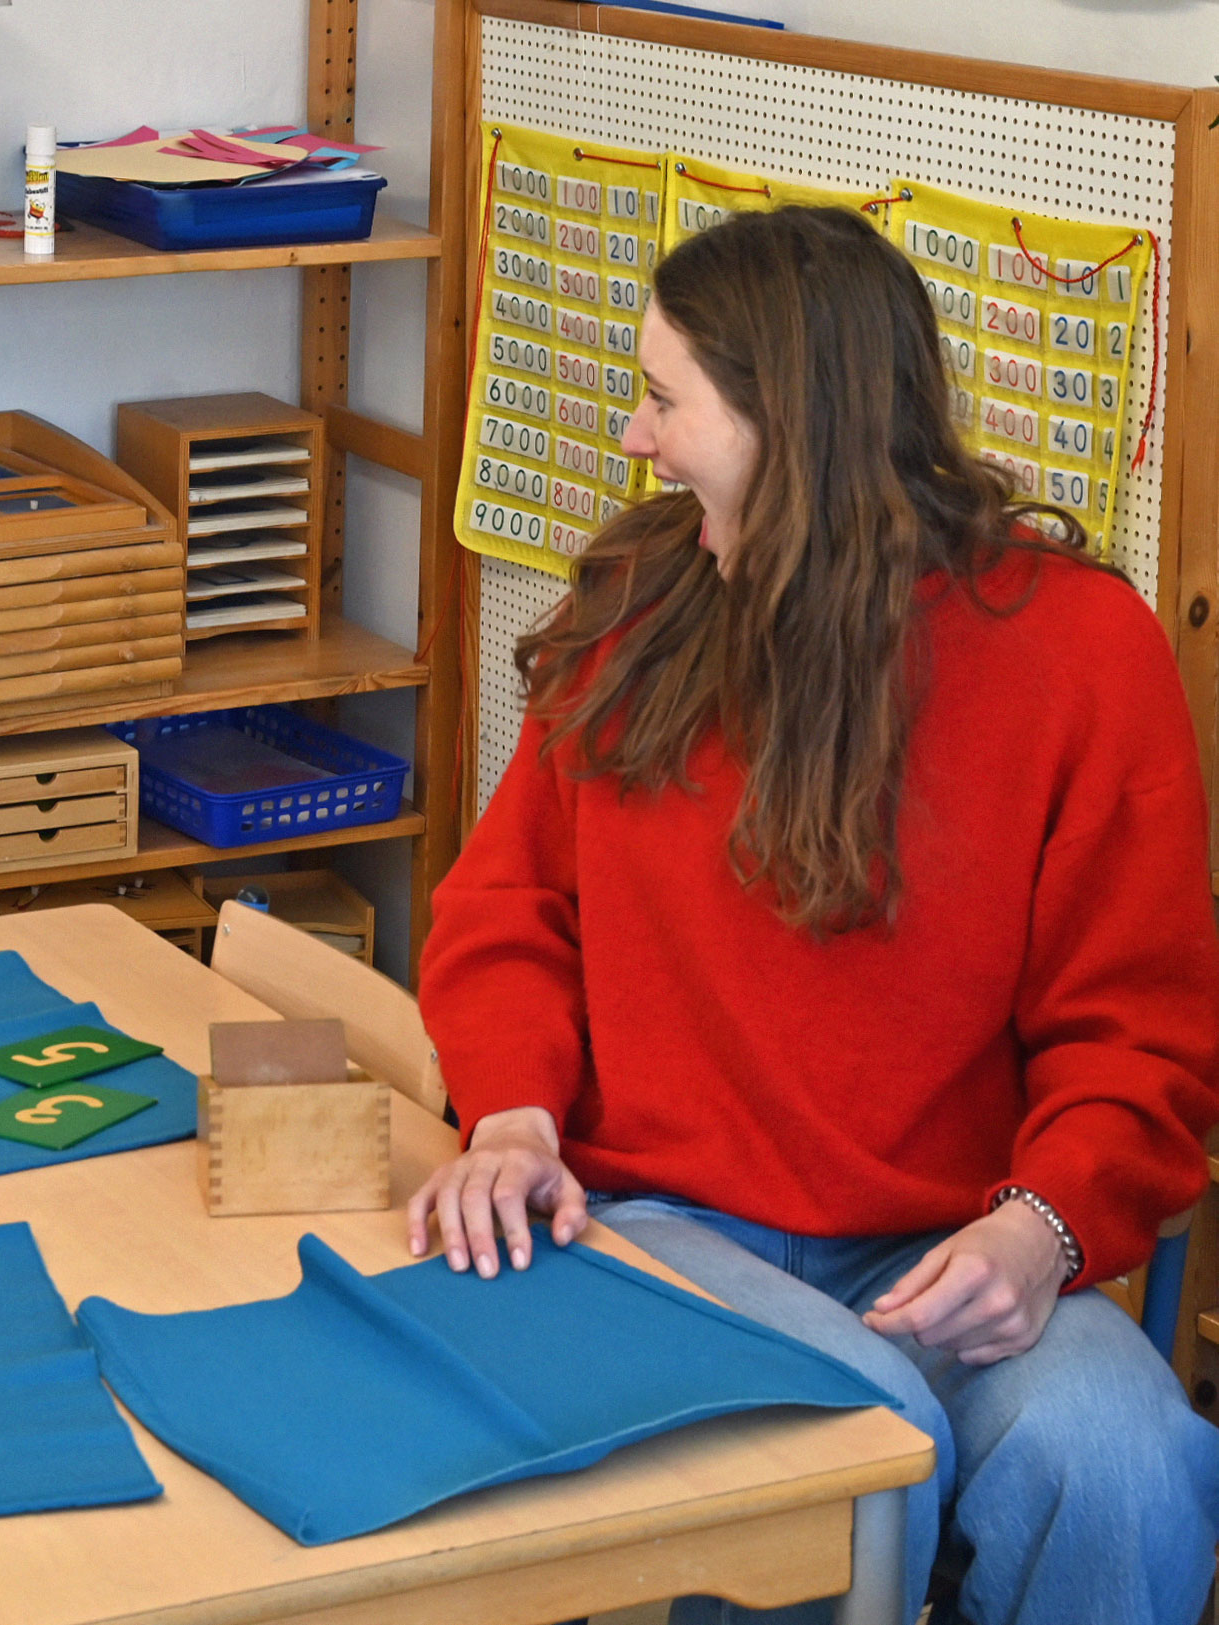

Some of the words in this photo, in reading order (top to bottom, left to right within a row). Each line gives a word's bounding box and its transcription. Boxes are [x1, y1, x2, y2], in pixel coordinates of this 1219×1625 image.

[501, 163, 547, 198] 1000
[562, 180, 597, 210] 100
[614, 189, 635, 215] 10
[649, 195, 655, 221] 1
[684, 202, 722, 230] 100
[497, 206, 546, 240] 2000
[559, 223, 596, 255] 200
[609, 235, 634, 262] 20
[497, 251, 548, 286] 3000
[559, 269, 596, 300] 300
[611, 280, 634, 307] 30
[912, 224, 973, 268] 1000
[997, 249, 1042, 285] 100
[1065, 262, 1093, 295] 10
[1116, 270, 1123, 299] 1
[496, 293, 548, 327] 4000
[560, 313, 597, 344] 400
[608, 325, 632, 350] 40
[986, 302, 1035, 340] 200
[1055, 317, 1089, 349] 20
[1110, 325, 1122, 355] 2
[493, 336, 547, 371] 5000
[558, 355, 595, 387] 500
[606, 368, 630, 397] 50
[989, 356, 1037, 392] 300
[1053, 370, 1087, 401] 30
[1101, 378, 1113, 408] 3
[489, 377, 546, 414] 6000
[558, 400, 595, 430] 600
[985, 403, 1034, 442] 400
[1053, 420, 1087, 452] 40
[486, 418, 545, 456] 7000
[559, 441, 595, 475] 700
[606, 456, 625, 485] 70
[479, 458, 543, 498] 8000
[553, 481, 591, 516] 800
[1051, 472, 1084, 505] 50
[1098, 482, 1108, 513] 5
[474, 503, 541, 541] 9000
[11, 1042, 109, 1067] 5
[15, 1094, 104, 1124] 3
